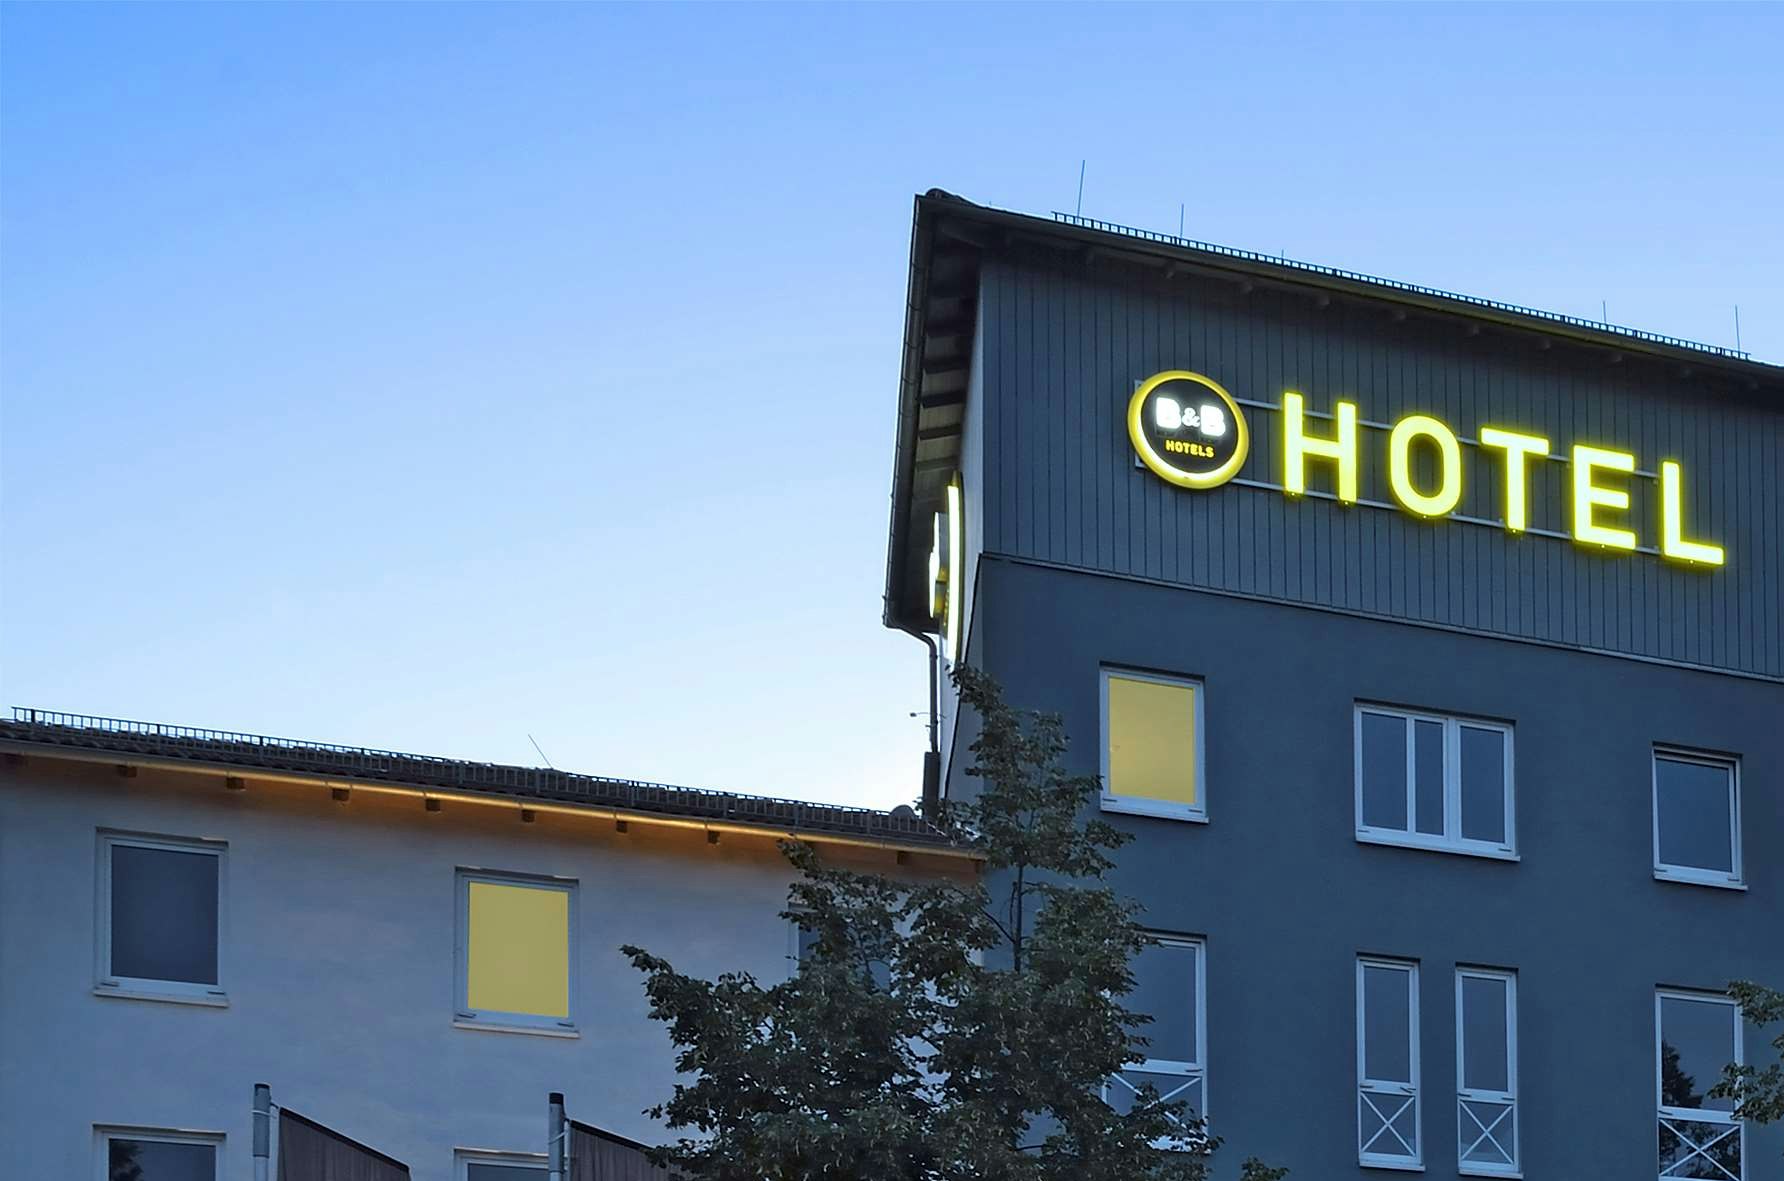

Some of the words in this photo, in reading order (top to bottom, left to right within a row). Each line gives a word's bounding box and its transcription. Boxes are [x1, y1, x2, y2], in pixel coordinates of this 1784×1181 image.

[1156, 397, 1226, 436] B&B
[1165, 440, 1214, 458] HOTELS
[1284, 392, 1725, 566] HOTEL
